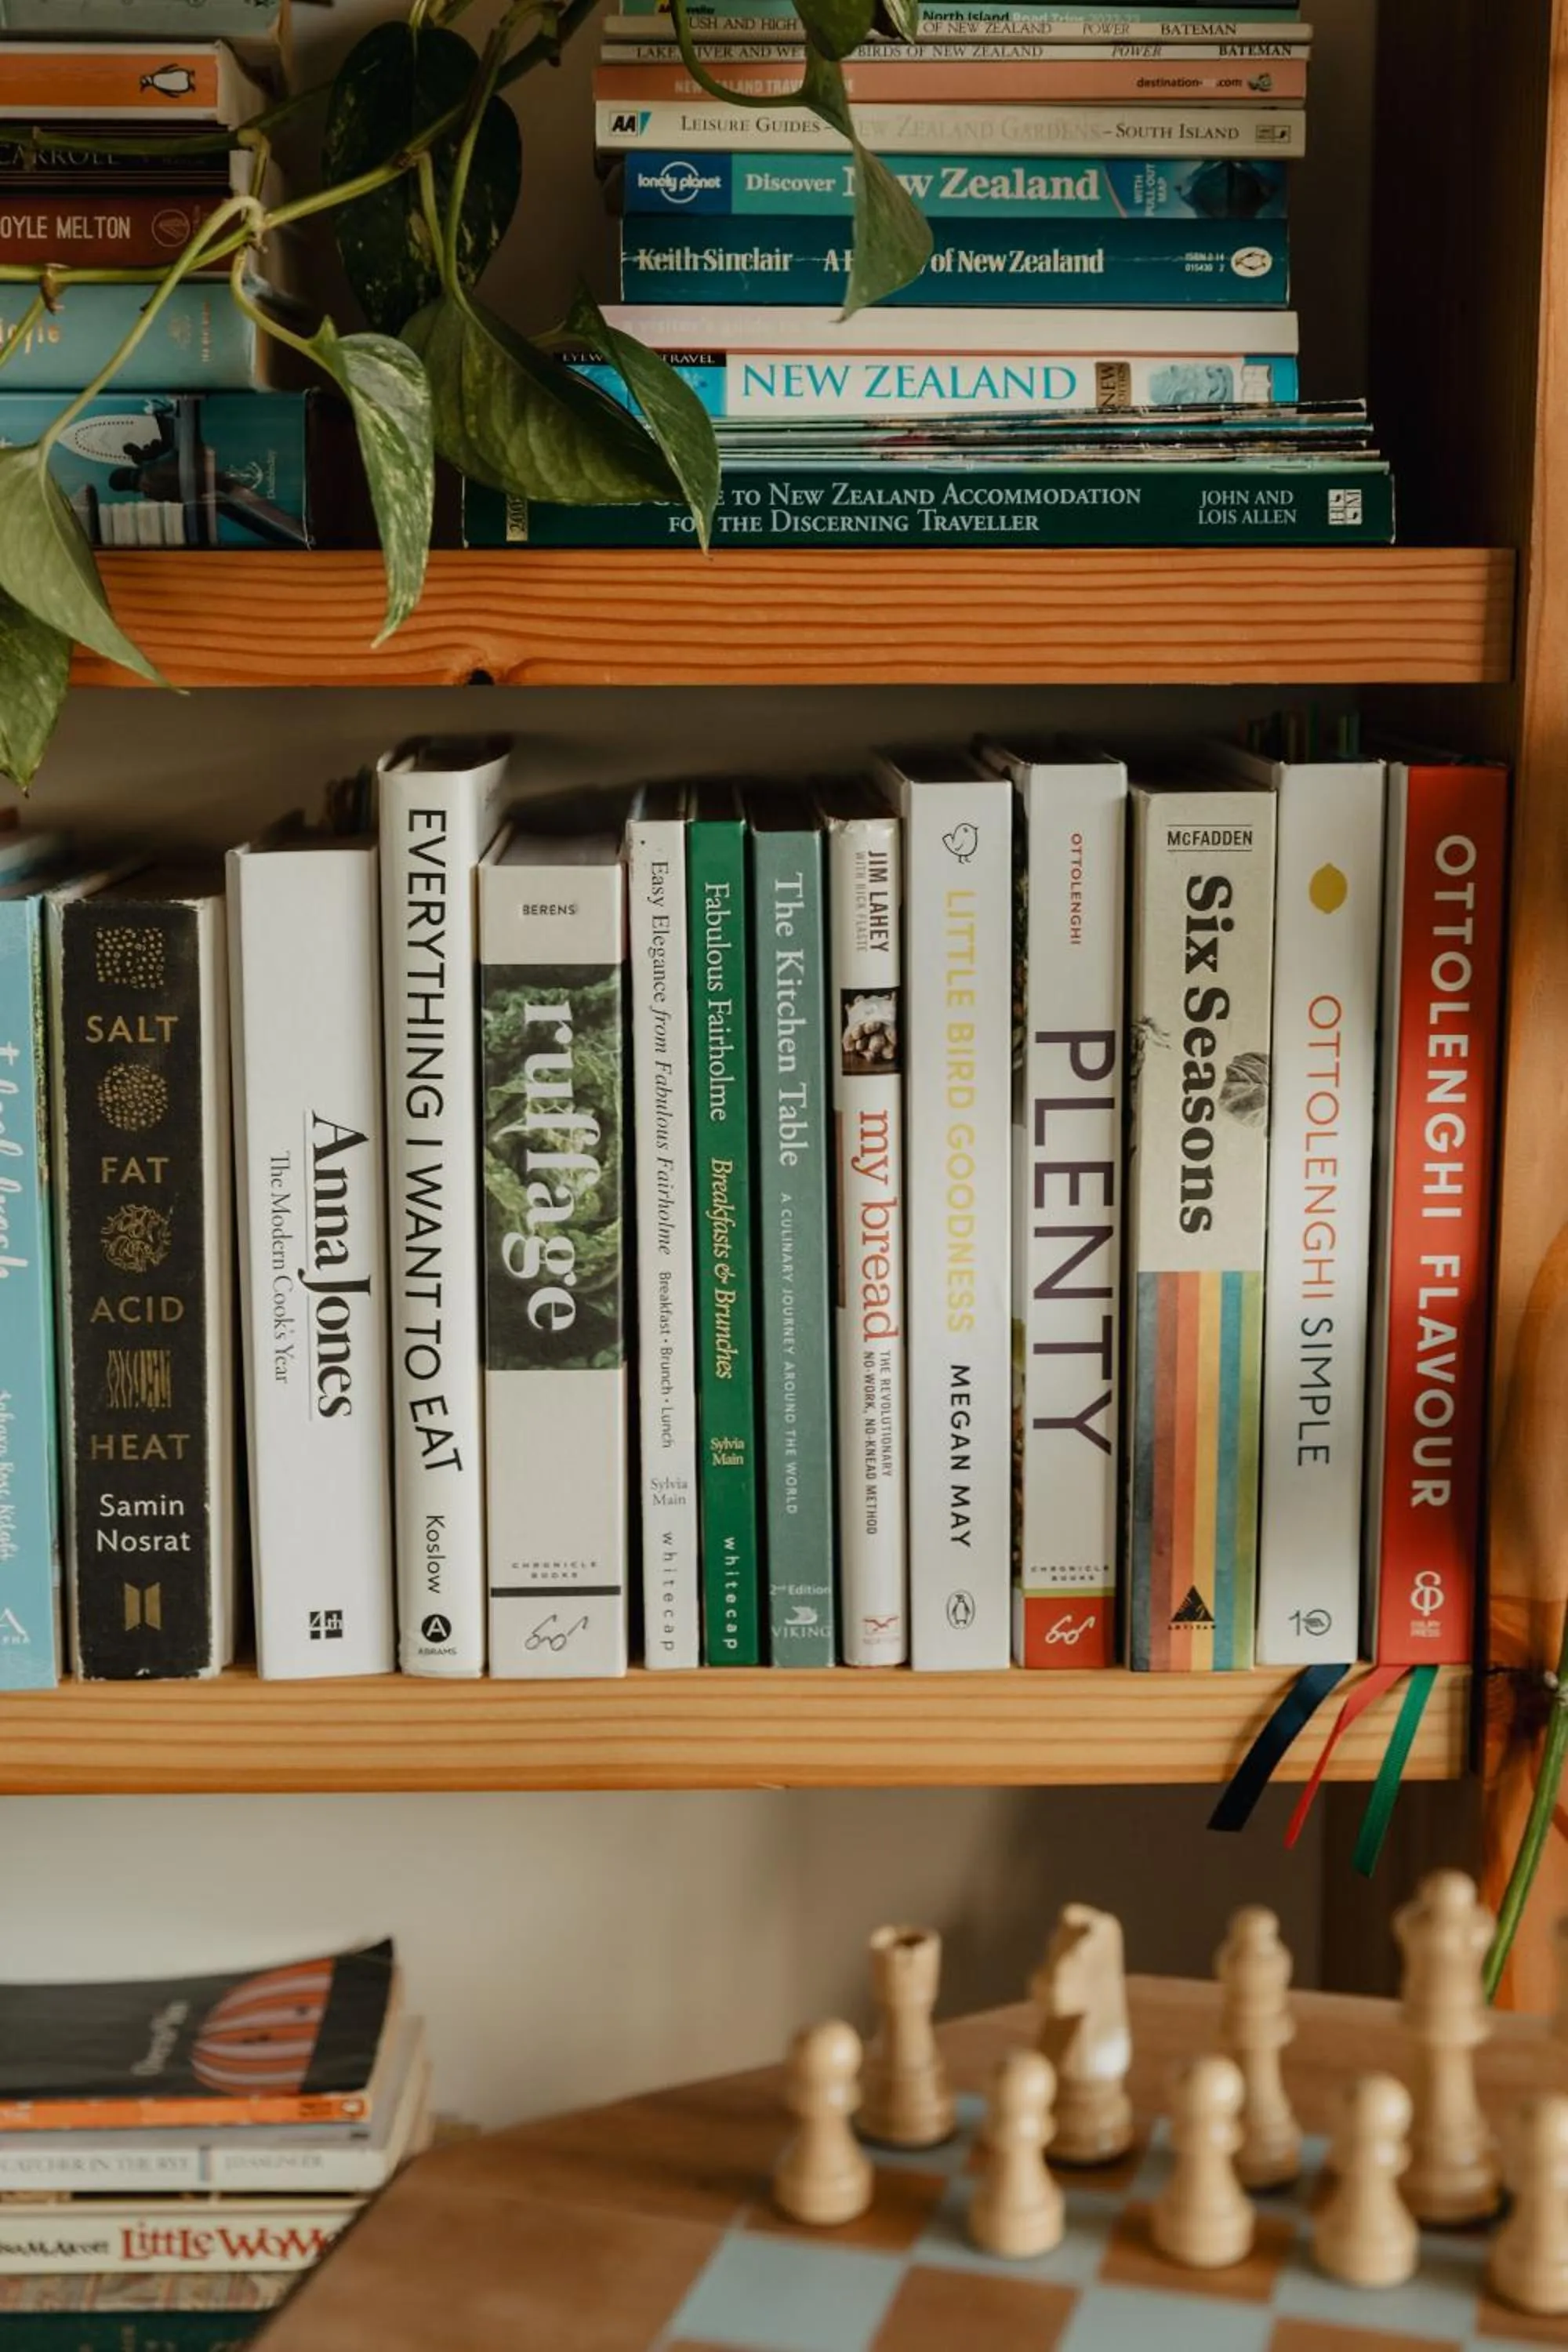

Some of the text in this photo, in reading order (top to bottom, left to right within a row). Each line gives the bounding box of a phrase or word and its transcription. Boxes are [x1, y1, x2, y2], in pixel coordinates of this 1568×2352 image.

[724, 17, 797, 31] AND HIGH
[923, 22, 1237, 35] OF NEW ZEALAND POWER BATEMAN
[742, 46, 770, 59] AND
[858, 45, 1292, 57] BIRDS OF NEW ZEALAND POWER BATEMAN
[612, 112, 637, 132] AA
[681, 115, 750, 133] LEISURE
[755, 118, 821, 133] GUIDES
[1116, 123, 1173, 140] SOUTH
[1179, 124, 1240, 140] ISLAND
[637, 173, 721, 191] lonely planet
[746, 167, 1101, 201] Discover Zealand
[1134, 174, 1143, 205] WITH
[1145, 163, 1156, 217] PULL-OUT
[1157, 177, 1168, 203] MAP
[56, 216, 131, 240] MELTON
[637, 247, 699, 272] Keith
[703, 247, 793, 272] Sinclair
[823, 249, 840, 272] A
[930, 249, 955, 272] of
[956, 250, 1008, 273] New
[1009, 248, 1105, 274] Zealand
[743, 364, 1077, 400] NEW ZEALAND
[1102, 363, 1116, 408] NEW
[732, 489, 761, 506] TO
[768, 483, 825, 506] NEW
[832, 484, 935, 506] ZEALAND
[941, 483, 1142, 506] ACCOMMODATION
[1199, 490, 1294, 506] JOHN AND
[718, 510, 1040, 534] THE DISCERNING TRAVELLER
[1198, 509, 1298, 525] LOIS ALLEN
[1167, 829, 1254, 847] McFADDEN
[868, 851, 890, 953] JIM LAHEY
[1069, 832, 1083, 946] OTTOLENGHI
[521, 903, 578, 916] BERENS
[704, 881, 732, 993] Fabulous
[405, 808, 448, 1120] EVERYTHING
[85, 1016, 180, 1044] SALT
[706, 999, 735, 1122] Fairholme
[1179, 874, 1235, 1234] Six Seasons
[946, 890, 976, 1332] LITTLE BIRD GOODNESS
[100, 1156, 170, 1184] FAT
[493, 1000, 602, 1331] ruffage
[647, 861, 677, 1449] Easy Elegance from Fabulous Fairholme Breakfast Brunch Lunch
[1411, 833, 1477, 1508] OTTOLENGHI FLAVOUR
[706, 1157, 736, 1259] Breakfasts
[774, 872, 809, 1515] The Kitchen Table A CULINARY JOURNEY AROUND THE WORLD
[404, 1164, 444, 1308] WANT
[851, 1109, 900, 1343] my bread
[1297, 994, 1342, 1468] OTTOLENGHI SIMPLE
[1033, 1029, 1116, 1457] PLENTY
[269, 1150, 296, 1384] The Modern Cook's Year
[297, 1110, 372, 1419] Anna Jones
[90, 1296, 185, 1323] ACID
[714, 1287, 739, 1380] Brunches
[404, 1319, 442, 1381] TO
[879, 1350, 892, 1477] THE REVOLUTIONARY
[90, 1434, 191, 1461] HEAT
[408, 1395, 463, 1472] EAT
[710, 1437, 745, 1452] Sylvia
[864, 1418, 877, 1480] NO-KNEAD
[711, 1454, 745, 1467] Main
[950, 1364, 971, 1549] MEGAN MAY
[650, 1477, 689, 1492] Sylvia
[652, 1493, 688, 1507] Main
[100, 1494, 185, 1519] Samin
[865, 1483, 878, 1535] METHOD
[96, 1530, 192, 1553] Nosrat
[424, 1515, 446, 1595] Koslow
[511, 1560, 598, 1570] CHRONICLE
[531, 1571, 579, 1580] BOOKS
[659, 1532, 678, 1652] whitecap
[722, 1536, 740, 1650] whitecap
[789, 1583, 832, 1595] Edition
[771, 1625, 832, 1639] VIKING
[417, 1647, 457, 1656] ABRAMS
